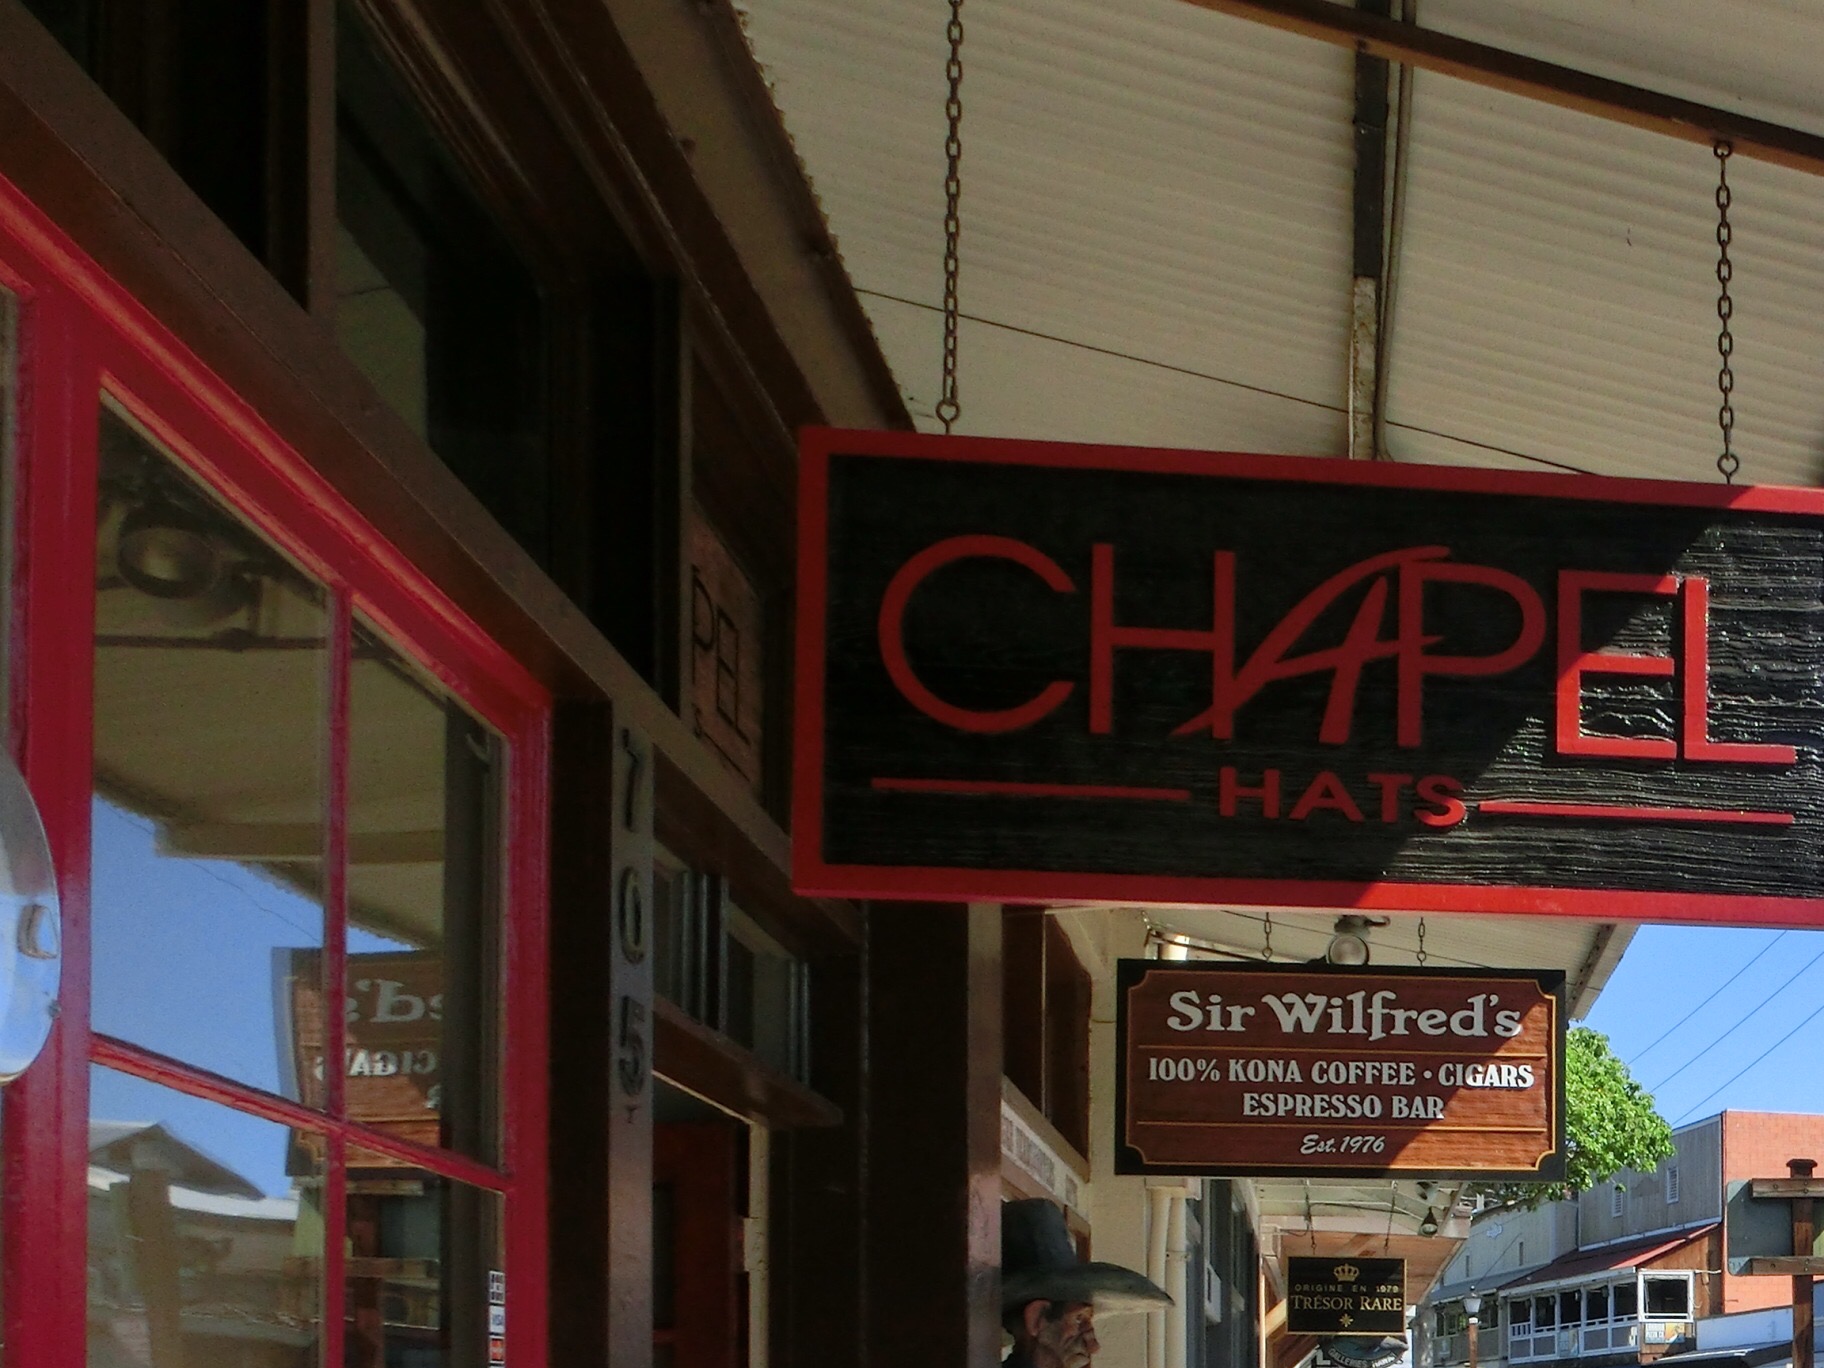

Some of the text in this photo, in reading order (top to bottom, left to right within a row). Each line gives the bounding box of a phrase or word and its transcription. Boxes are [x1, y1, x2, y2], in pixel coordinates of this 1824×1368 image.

[877, 534, 1796, 764] CHAPEL
[1219, 766, 1468, 831] HATS
[1167, 990, 1523, 1042] Sir Wilfred's
[1149, 1057, 1534, 1089] 100% KONA COFFEE CIGARS
[1242, 1093, 1445, 1120] ESPRESSO BAR
[1290, 1295, 1402, 1311] TRÉSOR RARE
[1294, 1284, 1343, 1293] ORIGINE
[1352, 1284, 1367, 1293] EN
